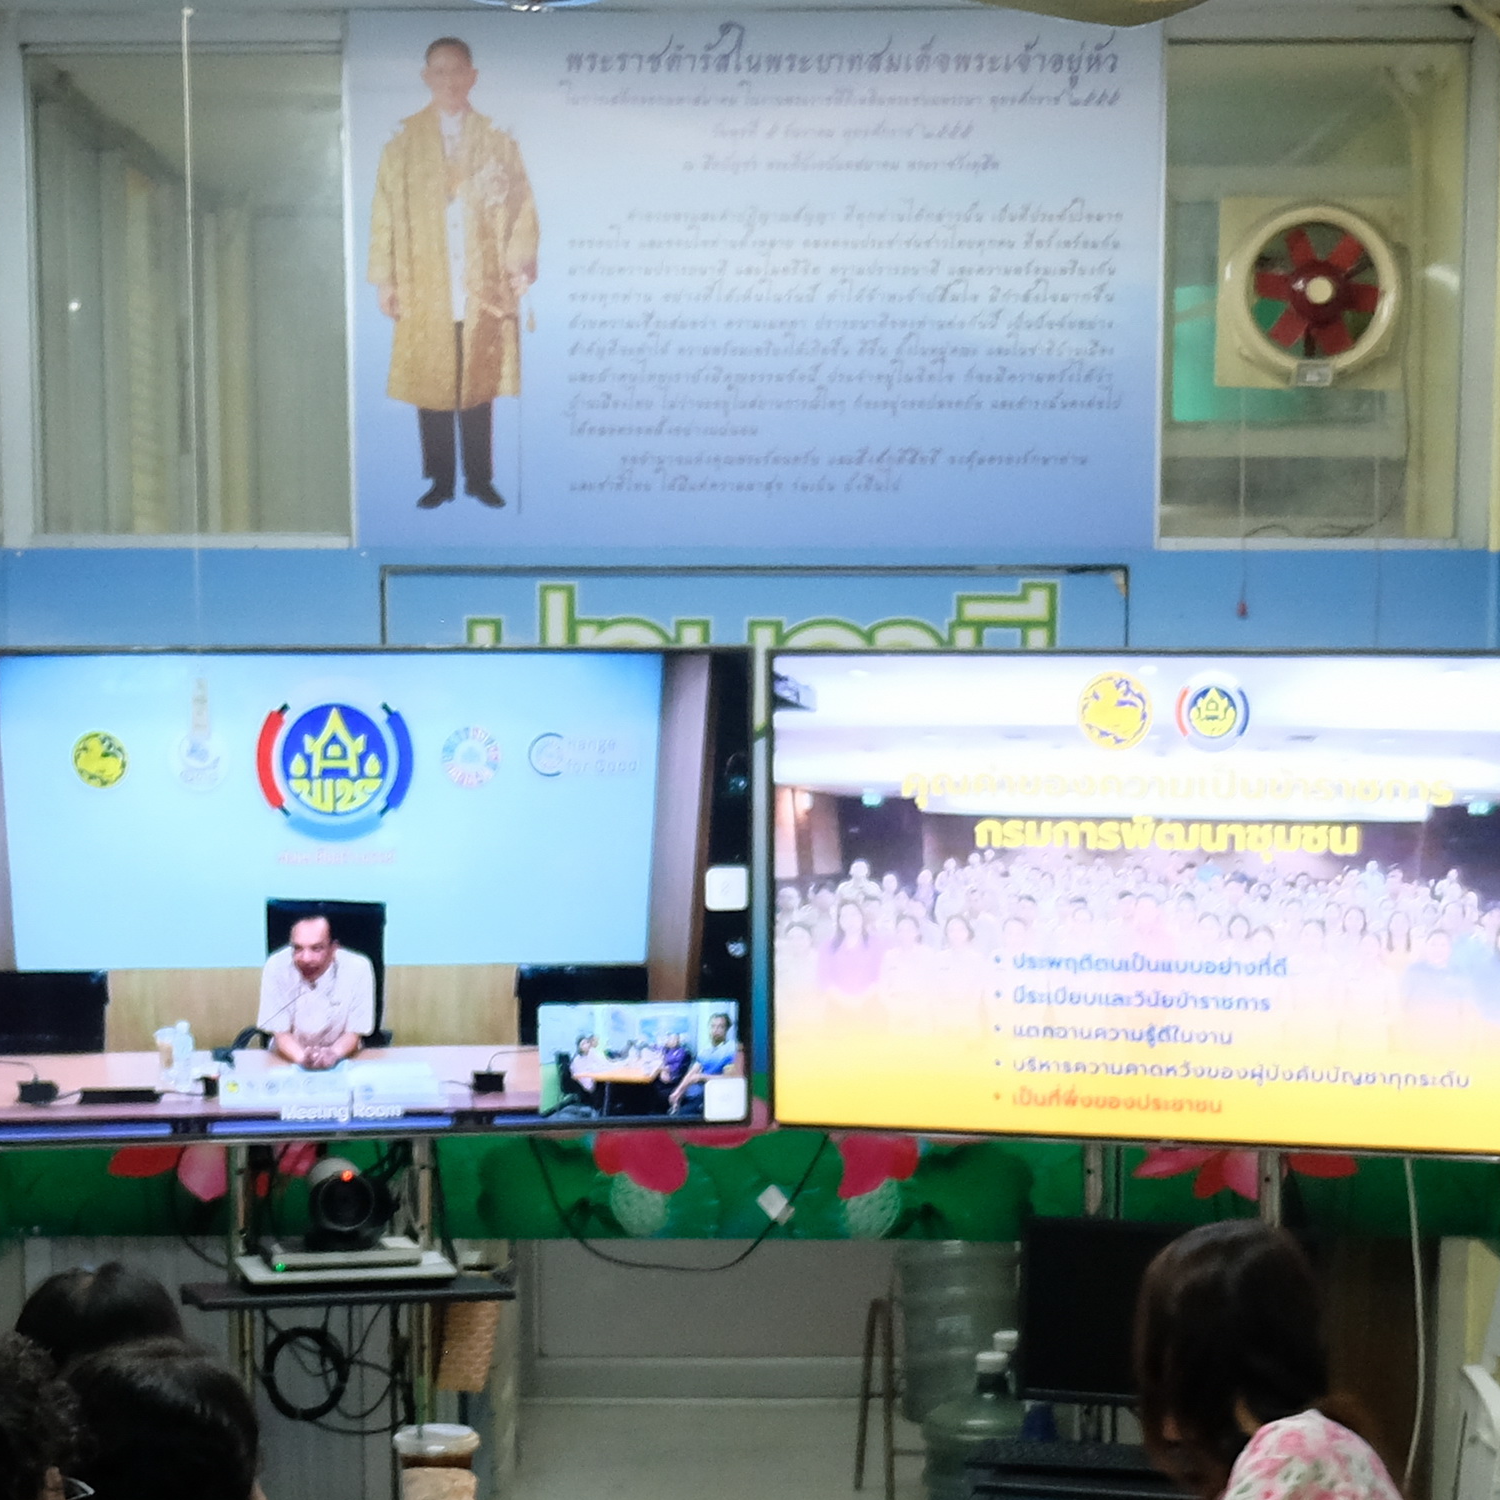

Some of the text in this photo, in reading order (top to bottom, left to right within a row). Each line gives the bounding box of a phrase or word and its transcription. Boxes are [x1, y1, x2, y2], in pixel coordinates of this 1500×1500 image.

[564, 21, 1120, 91] พระราชดำรัสในพระบาทสมเด็จพระเจ้าอยู่หัว
[973, 814, 1361, 864] กรมการพัฒนาชุมชน
[280, 1101, 403, 1123] Meeting Room
